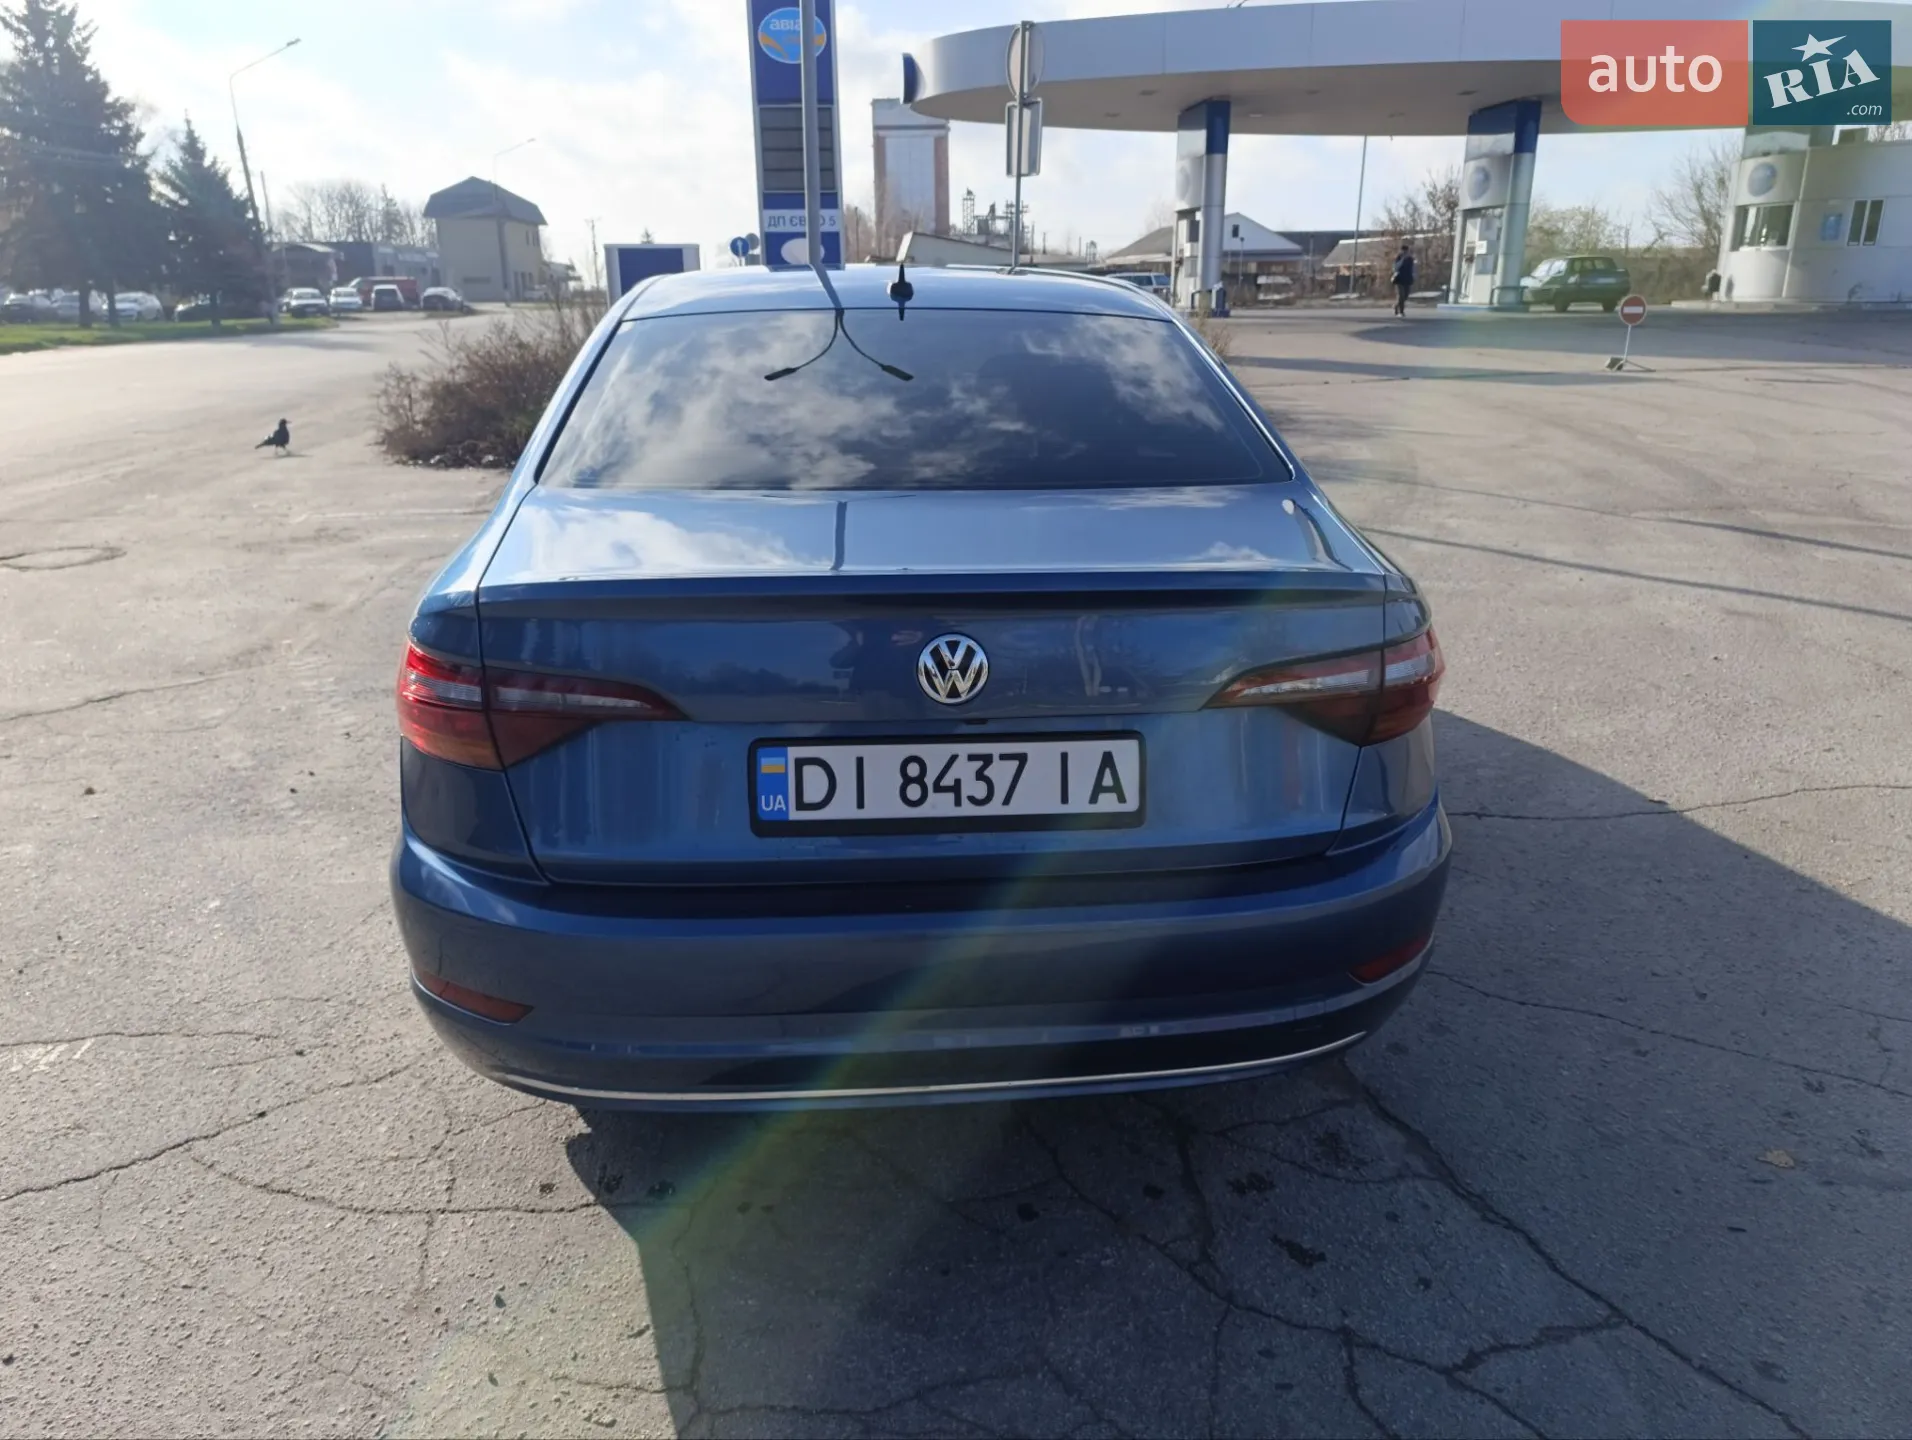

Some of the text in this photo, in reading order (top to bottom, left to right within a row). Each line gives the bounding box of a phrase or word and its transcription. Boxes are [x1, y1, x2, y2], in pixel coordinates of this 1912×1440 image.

[767, 215, 836, 228] ДП ЄВО 5
[794, 751, 1127, 811] DI 8437 IA
[761, 794, 786, 811] UA
